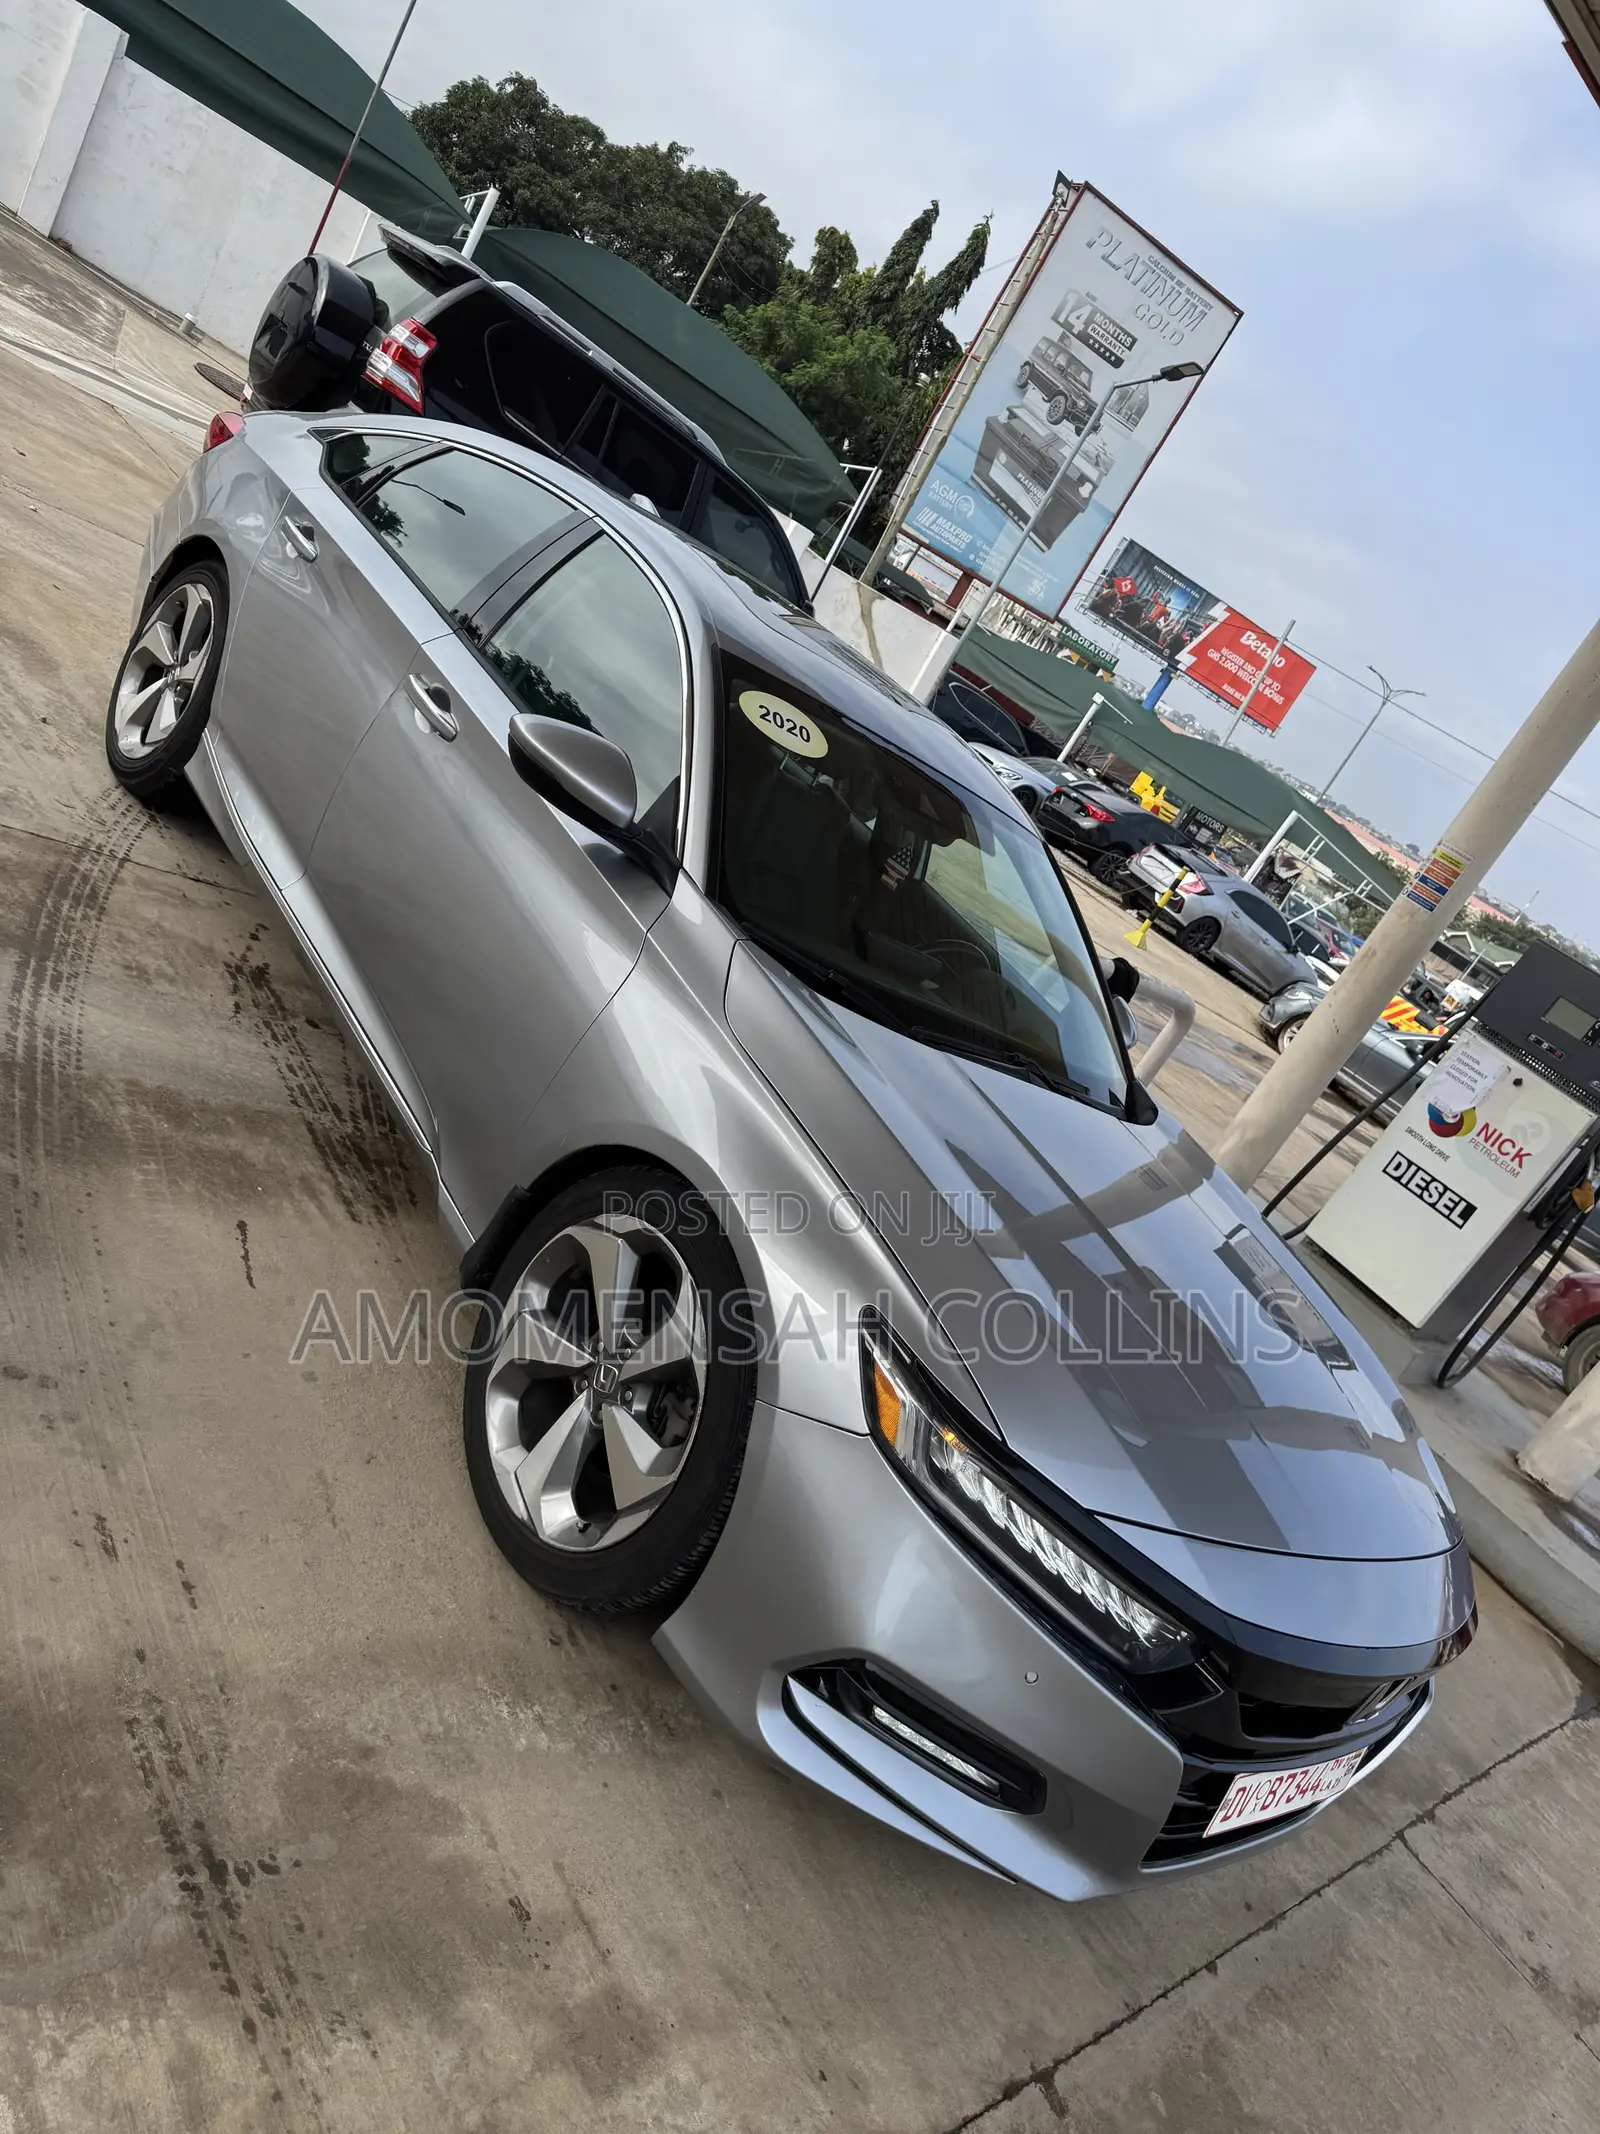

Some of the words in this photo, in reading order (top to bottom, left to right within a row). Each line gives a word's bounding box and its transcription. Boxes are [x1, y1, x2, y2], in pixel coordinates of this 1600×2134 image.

[1085, 226, 1208, 332] PLATINUM
[1058, 292, 1093, 334] 14
[1094, 312, 1133, 347] MONTHS
[1134, 303, 1185, 346] GOLD
[1090, 324, 1126, 355] WARRANTY
[930, 480, 958, 503] AGM
[1017, 472, 1047, 500] PLATINU
[930, 524, 967, 549] AUTOPARTS
[935, 516, 973, 543] MAXPRO
[1061, 626, 1117, 664] LABORATORY
[1220, 646, 1245, 667] REGISTER
[1243, 662, 1256, 674] AND
[1207, 648, 1221, 662] GHS
[1263, 687, 1285, 706] BONUS
[1271, 681, 1281, 692] TO
[758, 704, 811, 743] 2020
[1195, 811, 1225, 834] MOTORS
[1450, 1064, 1467, 1079] CLOSED
[1467, 1073, 1478, 1085] FOR
[1456, 1057, 1488, 1080] TEMPORARILY
[1461, 1050, 1481, 1066] STATION
[1404, 1126, 1425, 1144] SMOOTH
[1422, 1139, 1437, 1152] LONG
[1434, 1148, 1451, 1162] DRIVE
[1468, 1137, 1521, 1179] PETROLEUM
[1476, 1122, 1533, 1169] NICK
[1384, 1153, 1467, 1227] DIESEL
